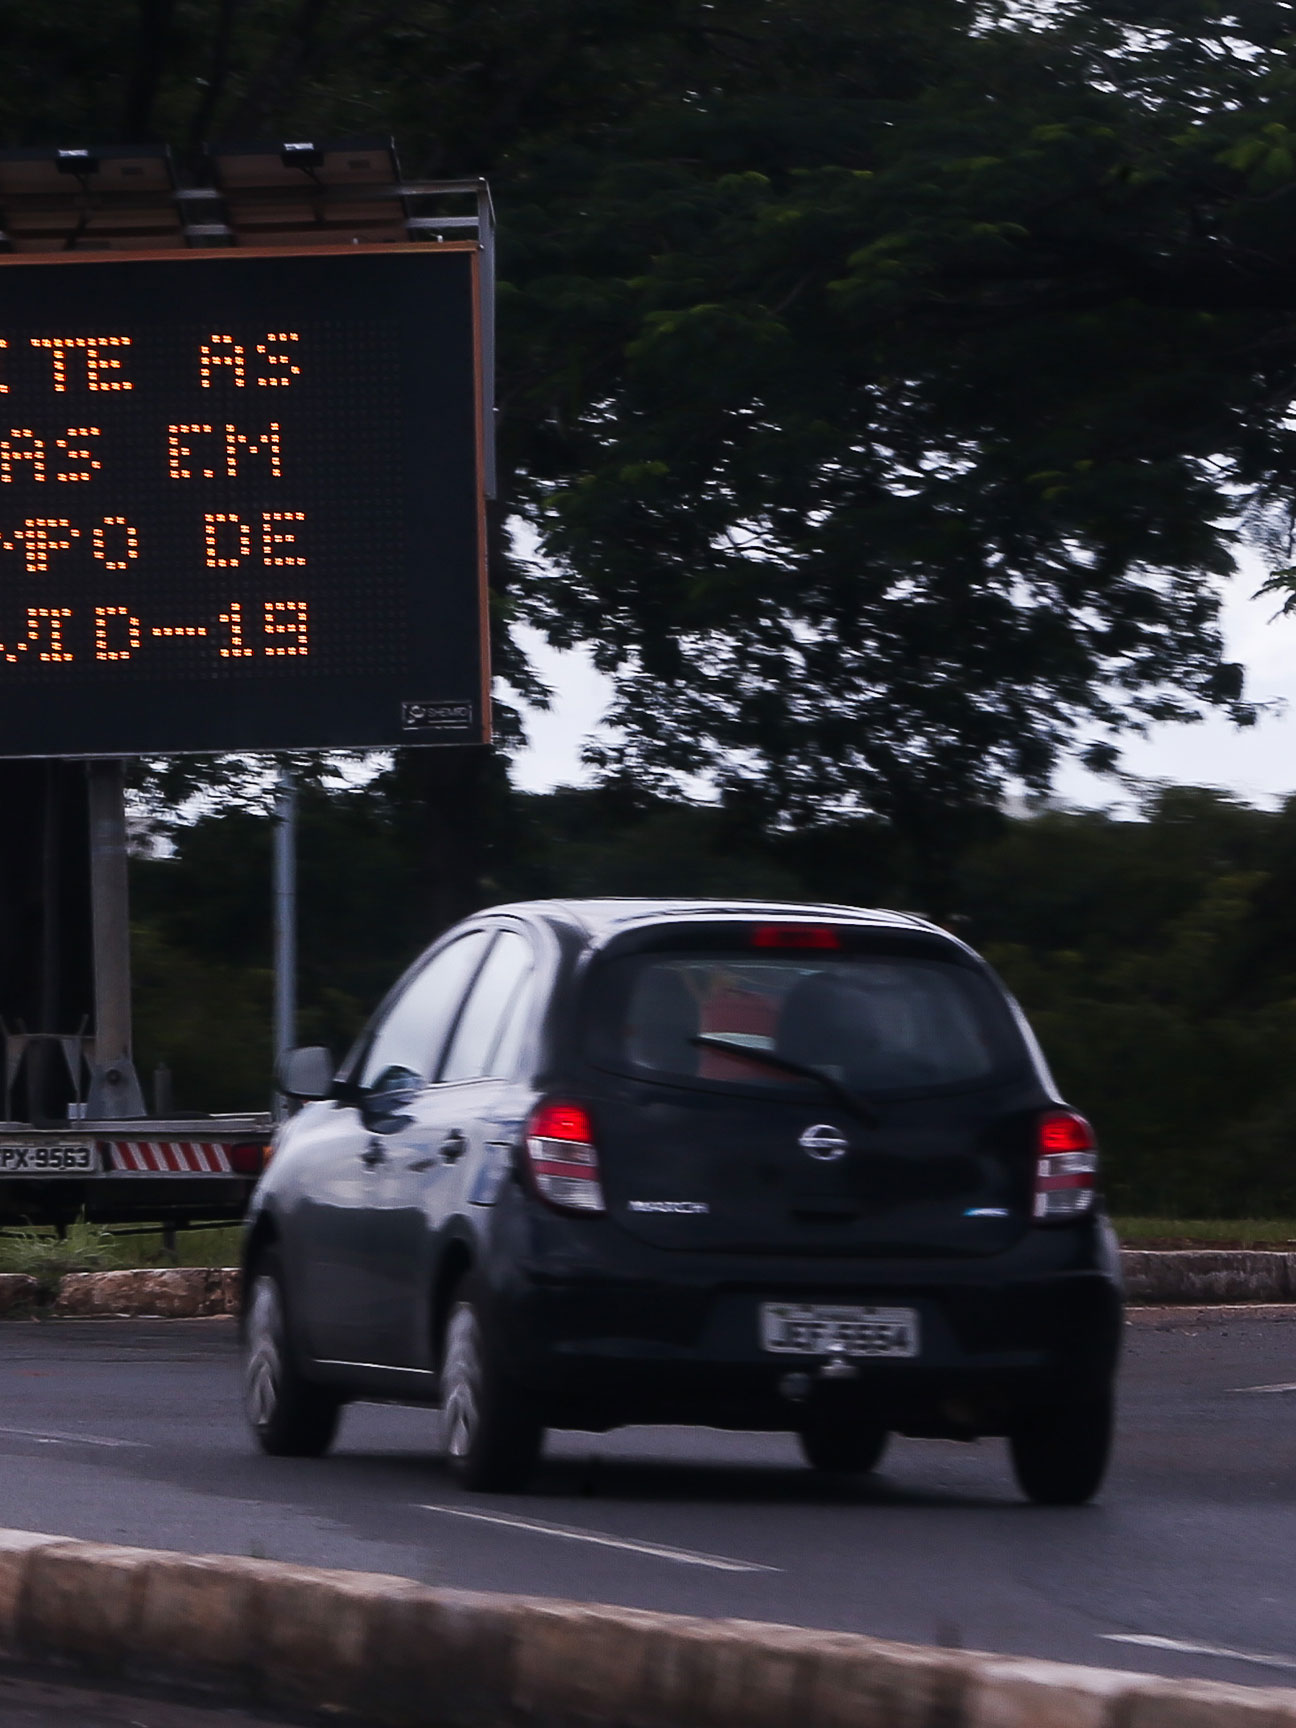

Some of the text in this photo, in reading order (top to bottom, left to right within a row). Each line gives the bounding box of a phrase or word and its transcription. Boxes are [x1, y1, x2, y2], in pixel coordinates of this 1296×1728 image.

[200, 332, 301, 388] AS
[168, 422, 282, 479] EM
[204, 511, 306, 568] DE
